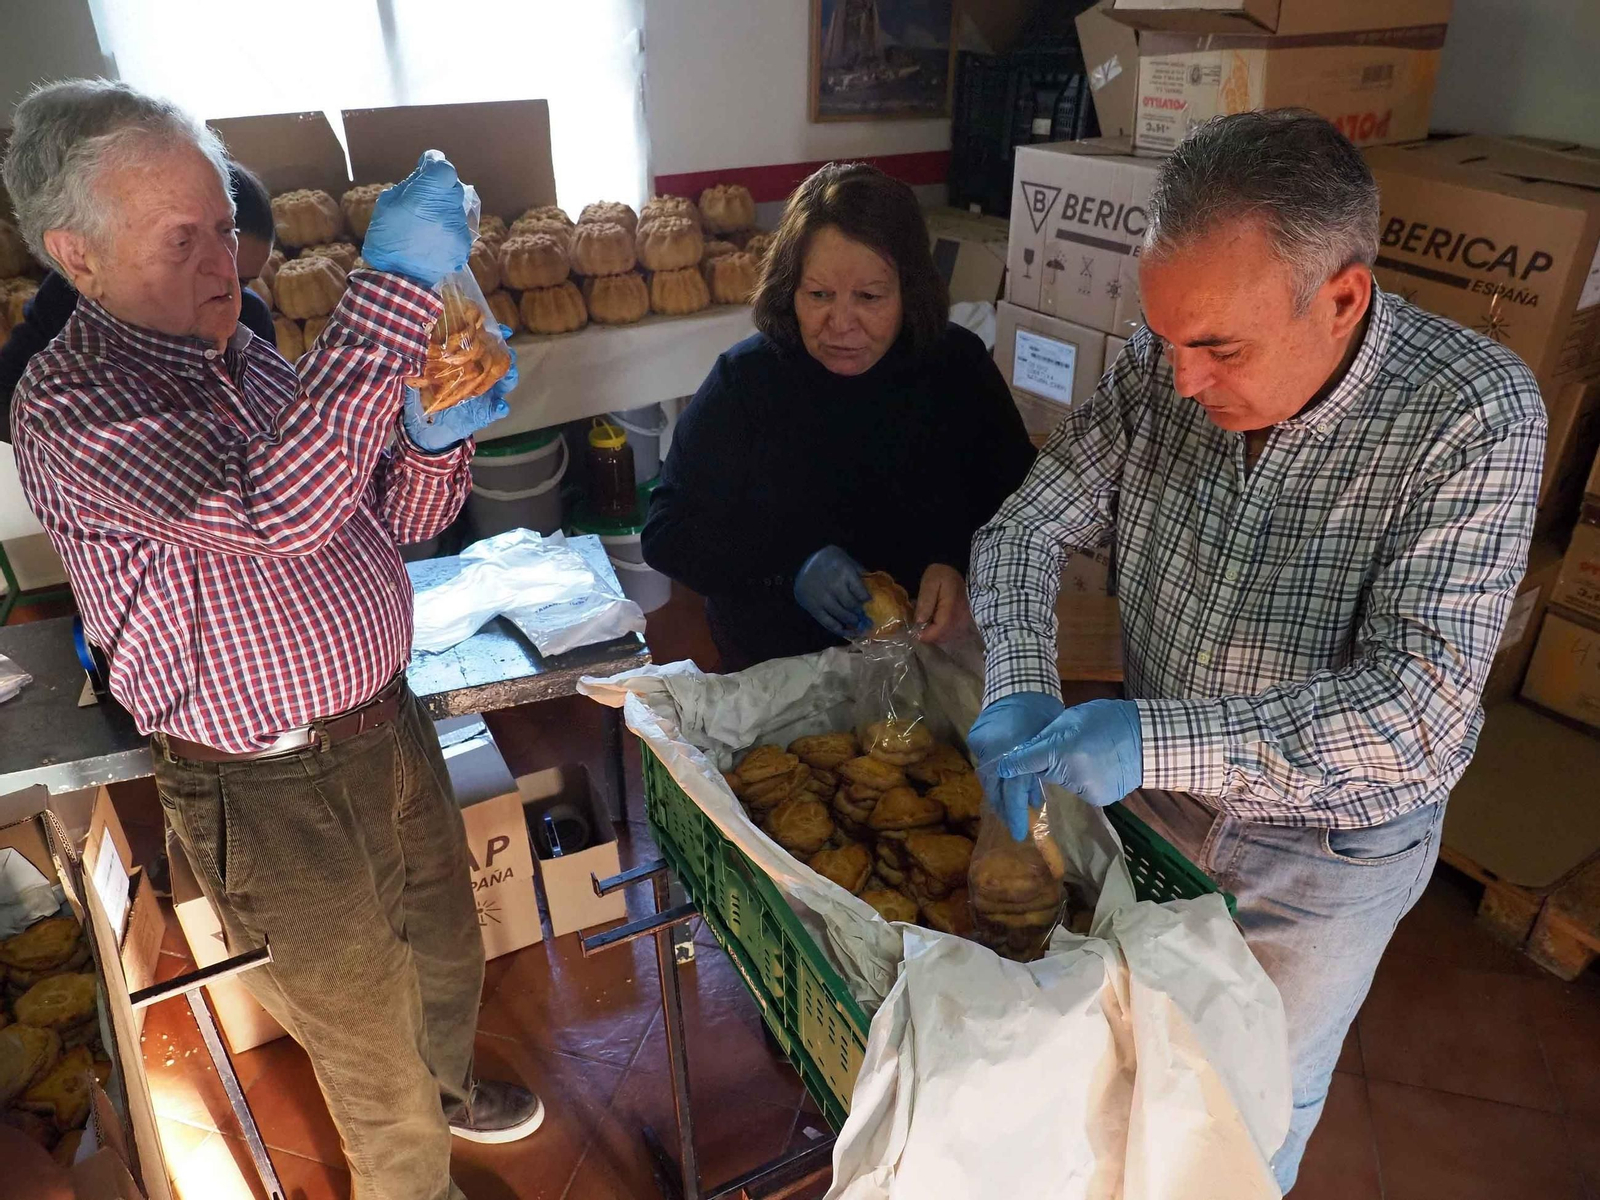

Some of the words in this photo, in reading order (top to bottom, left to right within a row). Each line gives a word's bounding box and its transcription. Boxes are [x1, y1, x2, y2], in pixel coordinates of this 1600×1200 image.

[1061, 193, 1148, 237] BERIC
[1380, 216, 1554, 281] BERICAP
[1471, 280, 1540, 308] ESPAÑA
